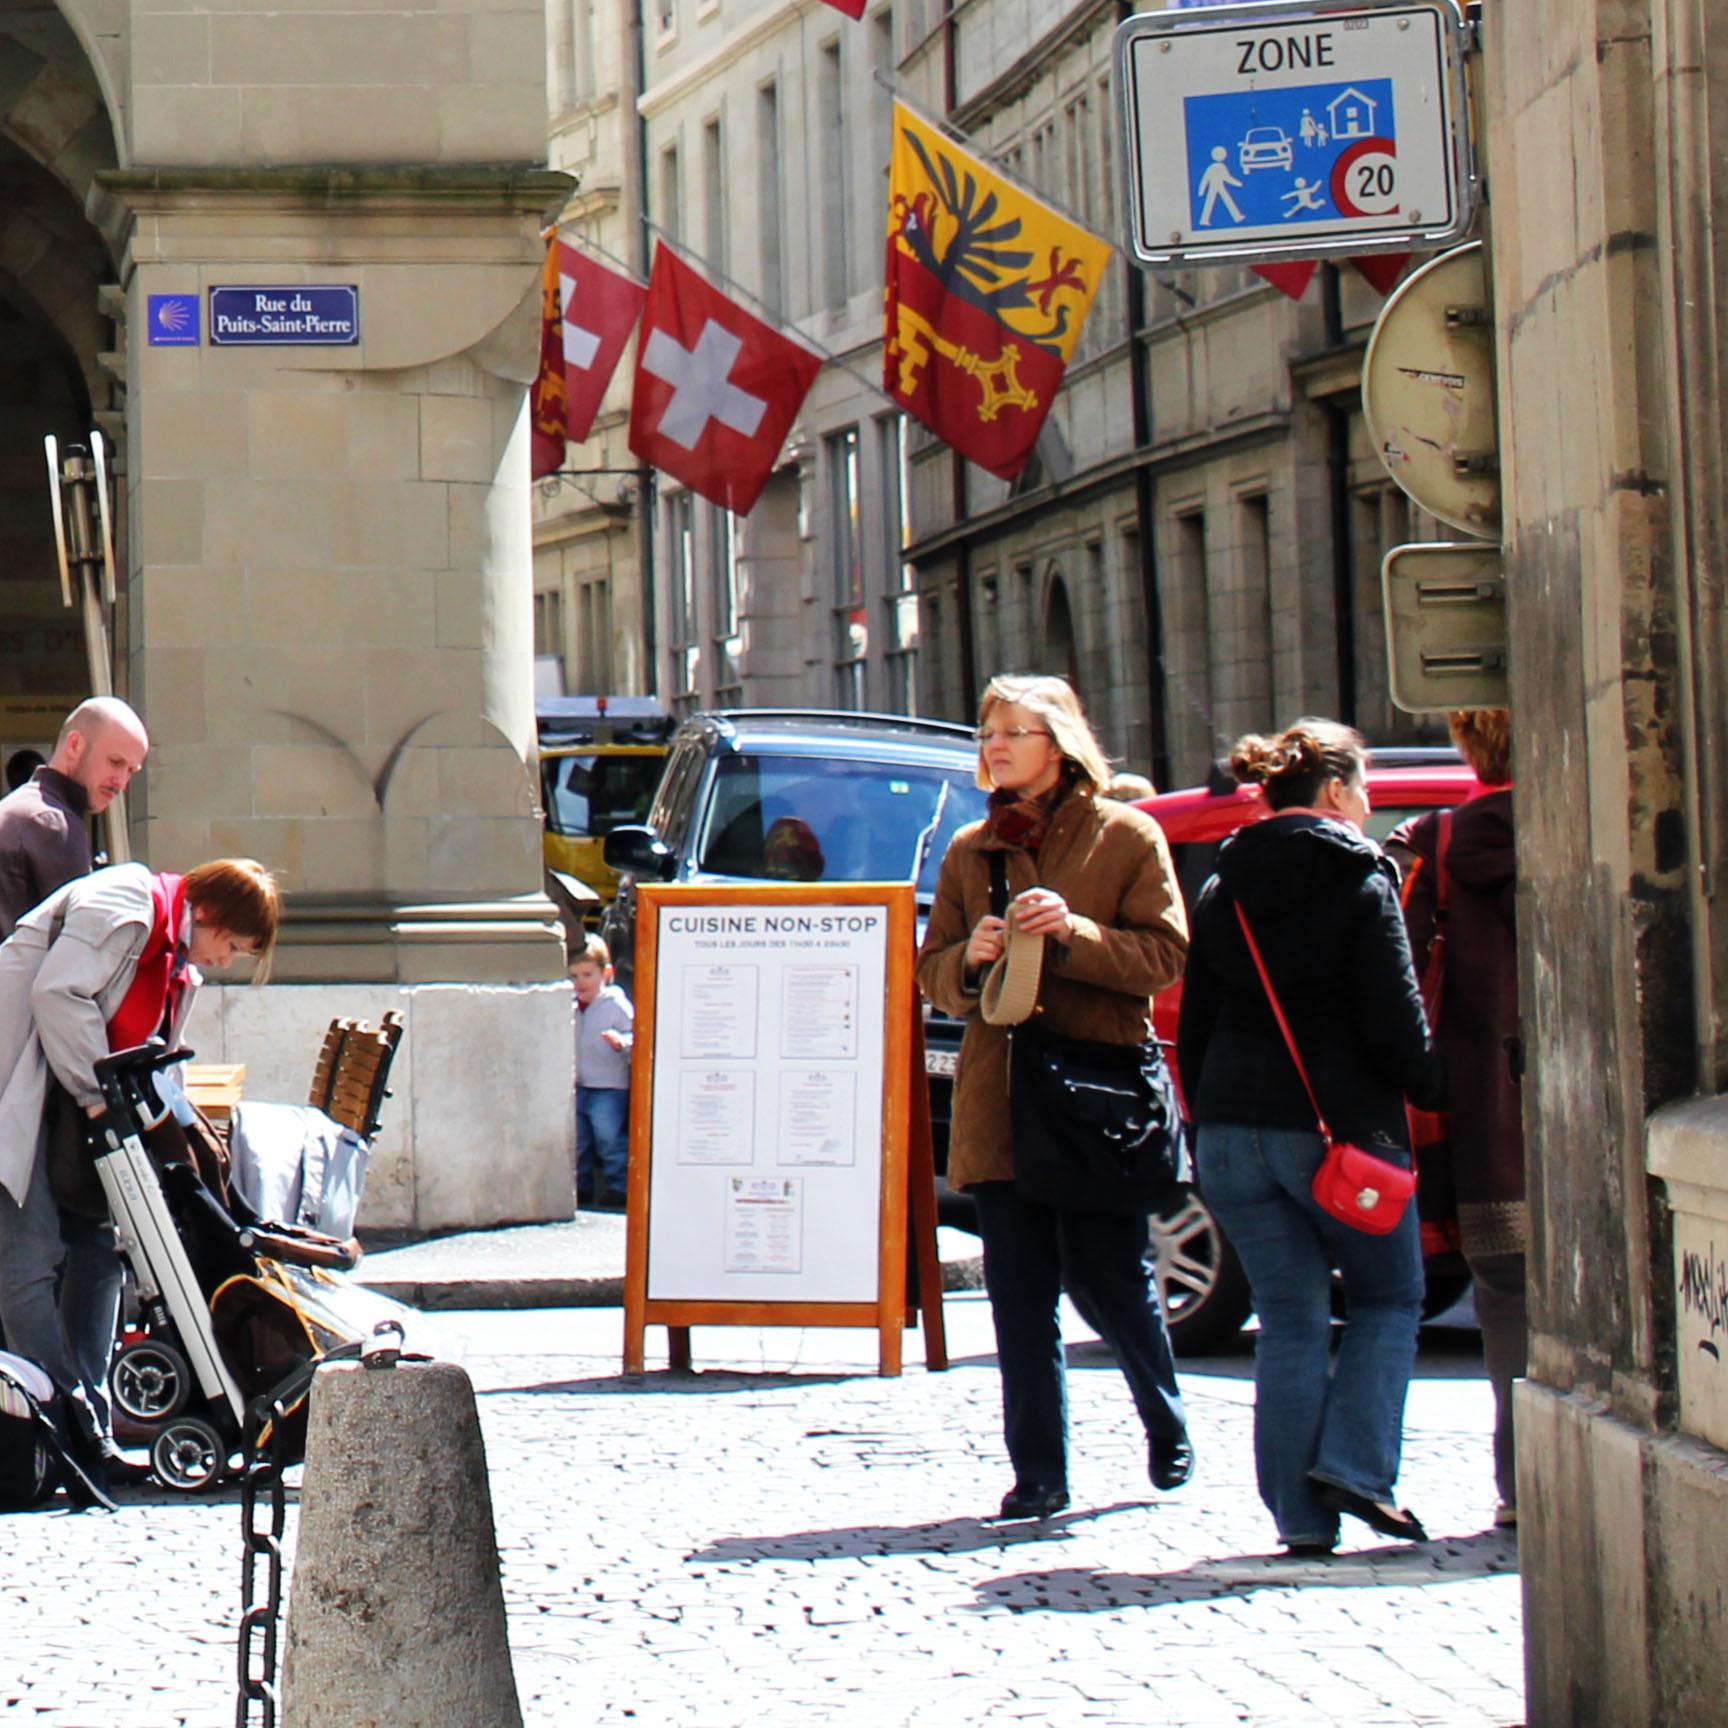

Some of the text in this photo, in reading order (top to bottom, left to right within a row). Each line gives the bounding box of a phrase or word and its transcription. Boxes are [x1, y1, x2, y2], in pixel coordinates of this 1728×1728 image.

[1235, 33, 1336, 75] ZONE
[1356, 162, 1395, 199] 20
[255, 293, 312, 313] Rue du
[217, 315, 351, 334] Puits-Saint-Pierre
[669, 916, 878, 933] CUISINE NON-STOP
